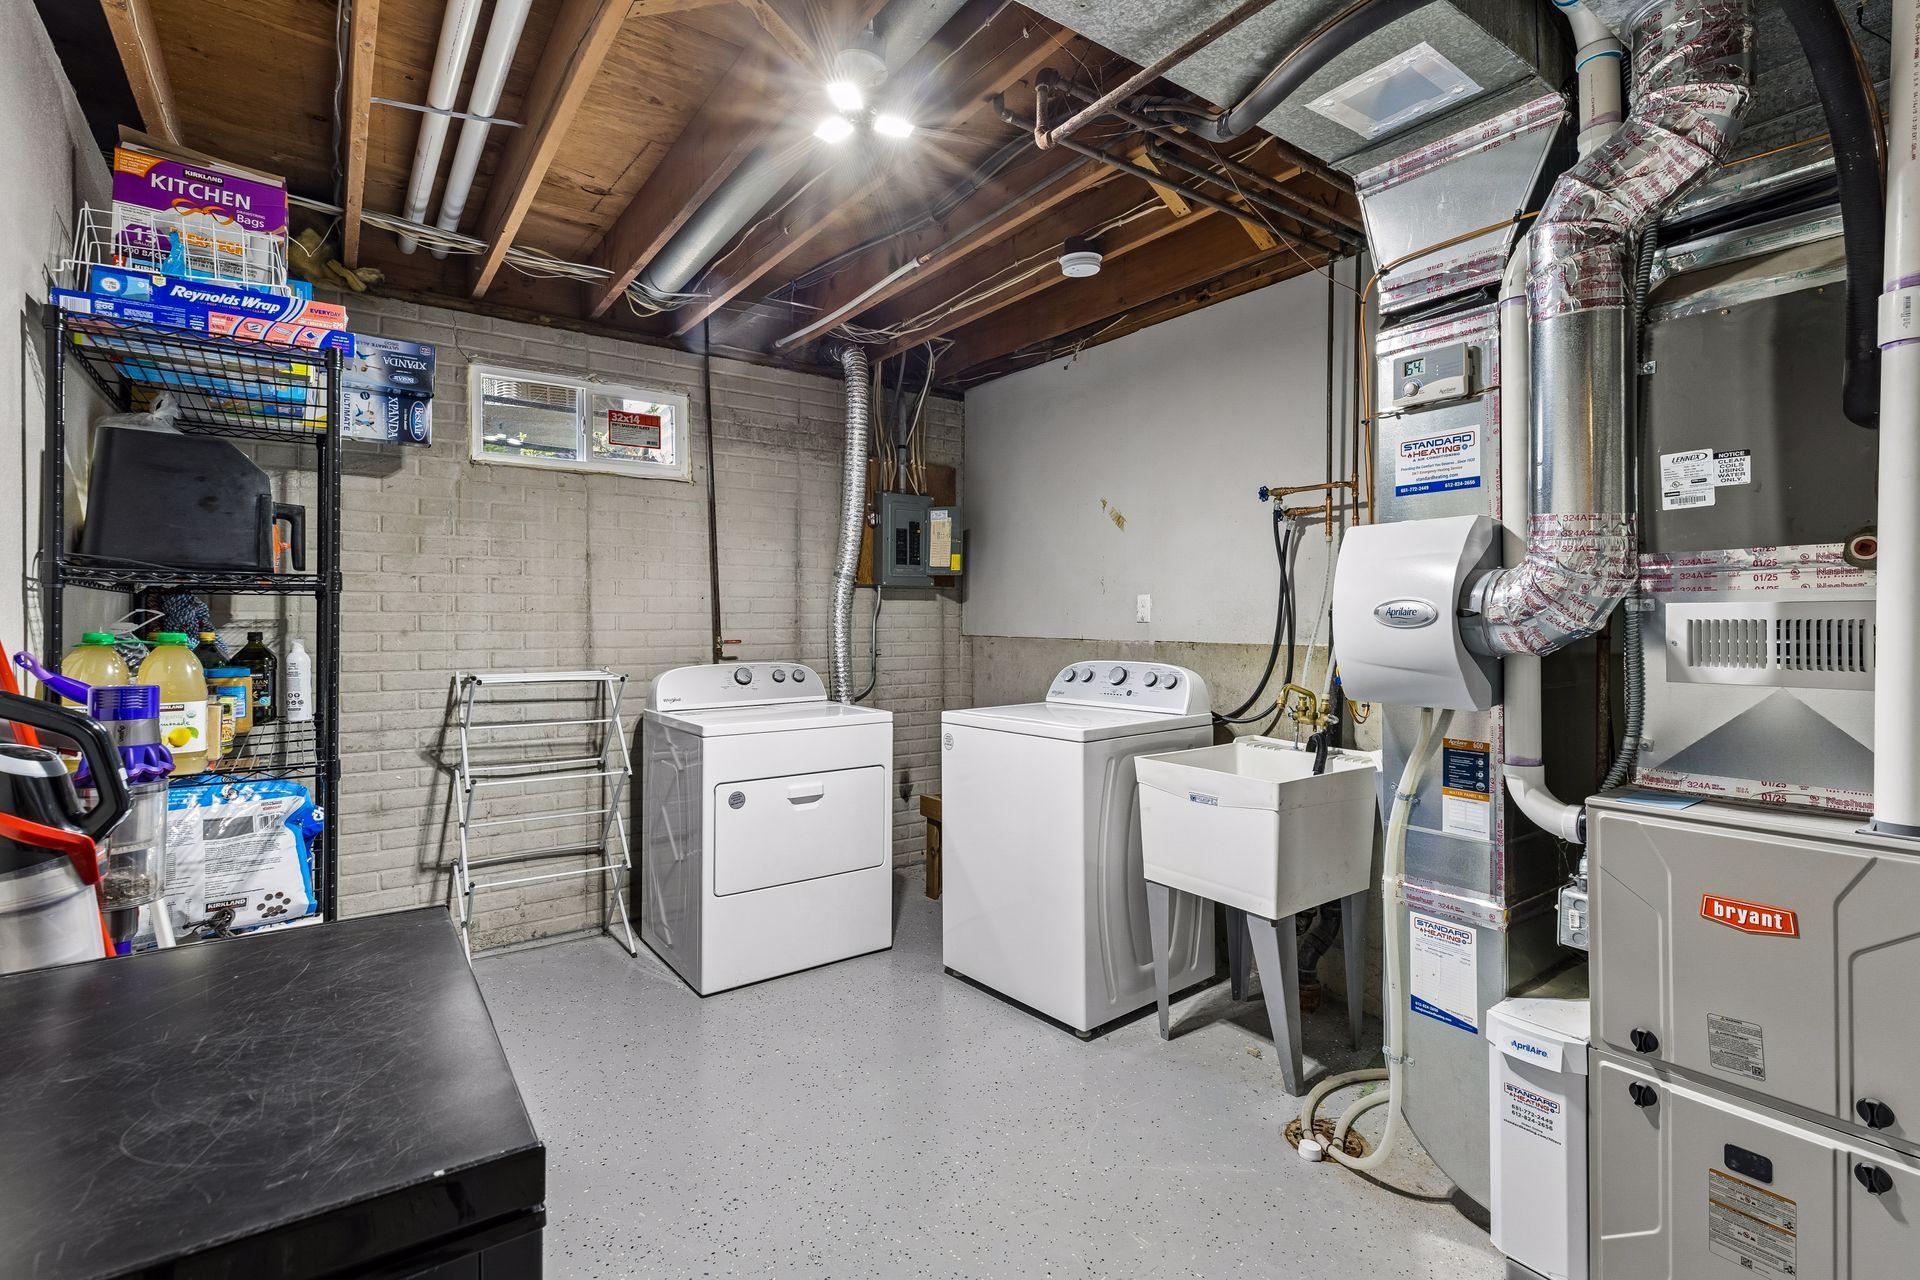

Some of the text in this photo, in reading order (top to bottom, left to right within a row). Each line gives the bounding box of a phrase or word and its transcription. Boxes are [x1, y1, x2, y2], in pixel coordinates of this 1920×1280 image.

[184, 169, 223, 184] KIRKLAND
[151, 173, 250, 210] KITCHEN
[236, 213, 265, 229] Bags
[170, 285, 281, 313] Reynolds Wrap
[310, 308, 342, 318] EVERYDAY
[383, 356, 427, 370] XPANDA
[343, 393, 351, 431] ULTIMATE
[388, 396, 400, 438] XPANDA
[611, 413, 640, 424] 32x14
[415, 407, 424, 436] BestAir
[1403, 434, 1472, 451] STANDARD
[1413, 445, 1461, 458] HEATING
[1672, 454, 1702, 463] LENNOX
[1416, 473, 1458, 481] standardheating.com
[1752, 559, 1777, 567] 01/25
[1680, 572, 1703, 580] 324A
[1753, 574, 1778, 582] 01/25
[1386, 607, 1417, 618] Aprilaire
[1687, 781, 1711, 789] 324A
[1761, 793, 1787, 804] 01/25
[207, 898, 246, 909] KIRKLAND
[1714, 901, 1783, 929] bryant
[1416, 919, 1470, 939] STANDARD
[1423, 928, 1461, 943] HEATING
[1511, 1040, 1548, 1057] AprilAire
[1507, 1084, 1557, 1109] STANDARD
[1514, 1092, 1549, 1111] HEATING
[1512, 1104, 1553, 1125] 651-772-2449
